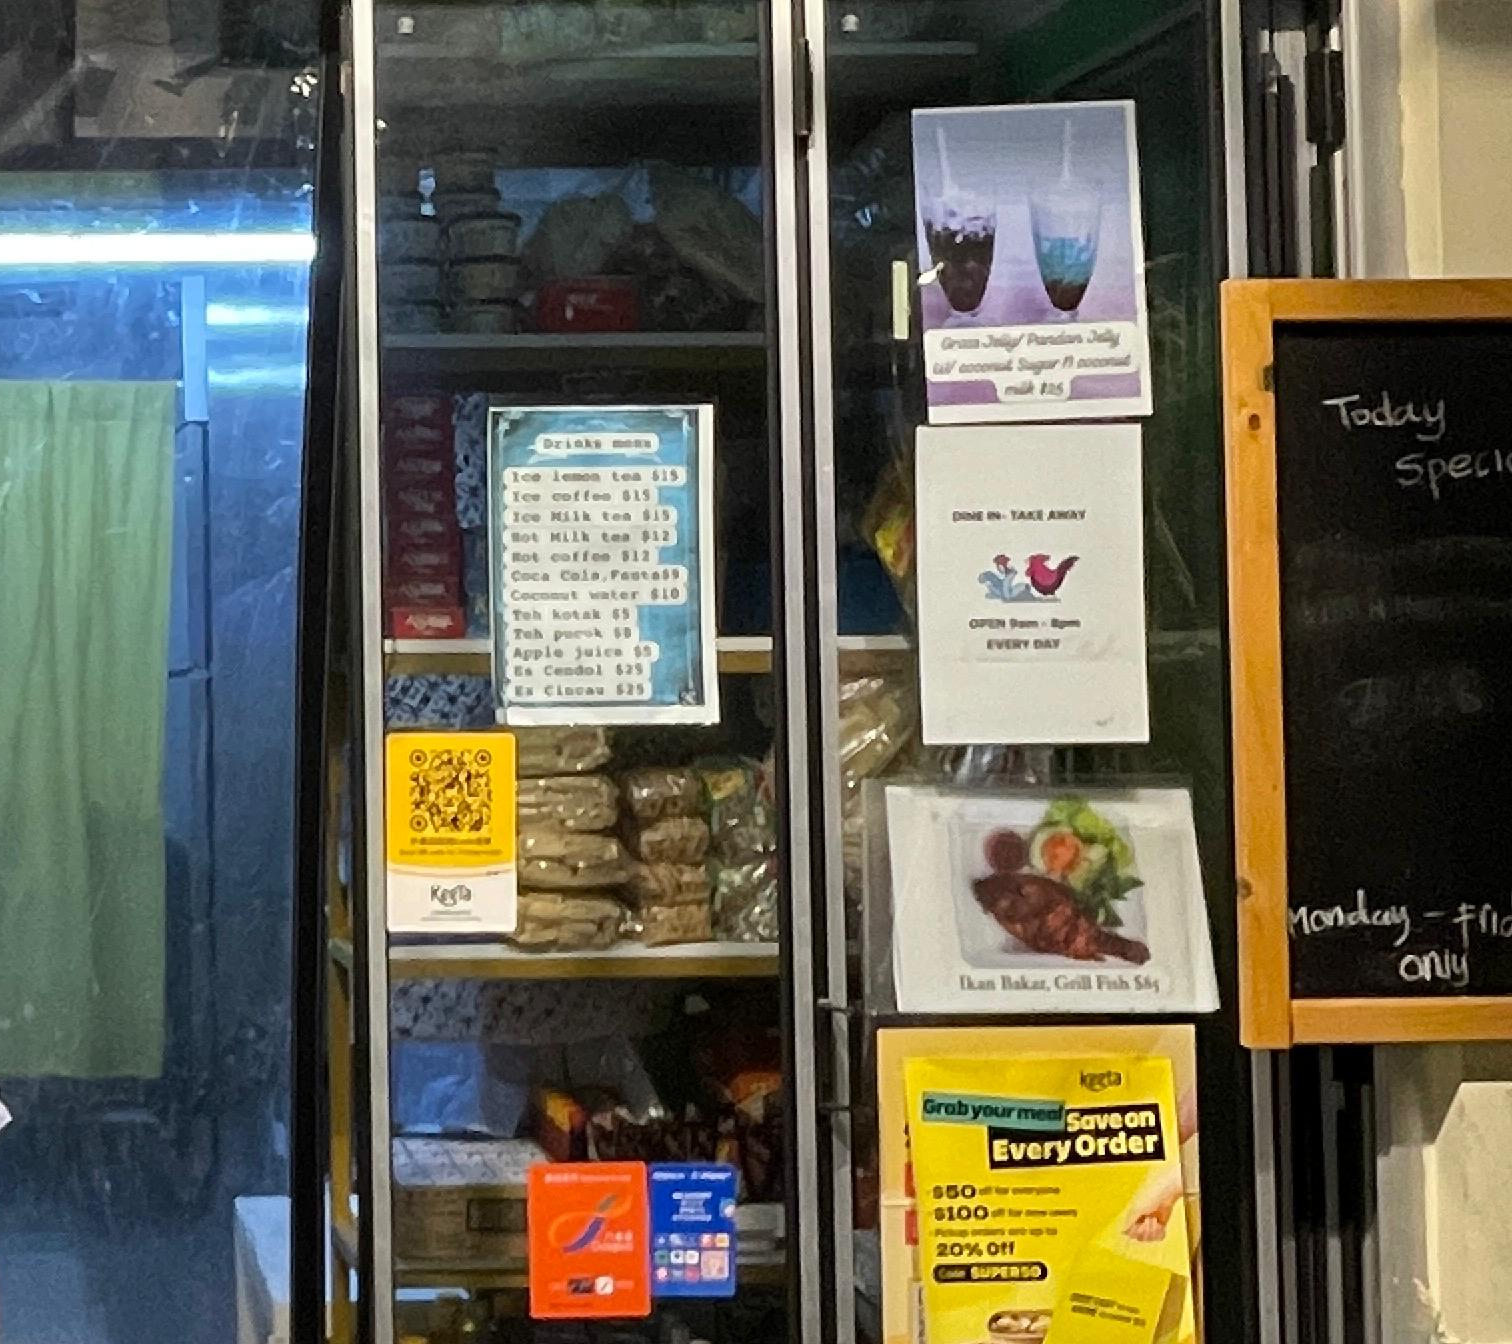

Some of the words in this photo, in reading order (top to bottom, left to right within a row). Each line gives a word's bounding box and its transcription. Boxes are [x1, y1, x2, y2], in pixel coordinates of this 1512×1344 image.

[1321, 390, 1446, 442] Today
[512, 470, 541, 483] Ice
[612, 470, 641, 482] tea
[512, 490, 541, 502] Ice
[552, 489, 611, 502] coffee
[512, 510, 541, 523] Ice
[602, 510, 632, 522] tea
[1011, 510, 1044, 521] TAKE
[1047, 509, 1086, 521] AWAY
[601, 531, 630, 543] tea
[550, 550, 610, 563] coffee
[969, 618, 1006, 629] OPEN
[986, 638, 1030, 650] EVERY
[1033, 638, 1061, 650] DAY
[513, 645, 563, 661] Apple
[1289, 887, 1411, 947] Monday
[1398, 949, 1470, 987] only
[959, 975, 995, 991] Ikan
[1096, 975, 1130, 991] Fish
[923, 1098, 969, 1116] Grab
[970, 1103, 1016, 1120] your
[1017, 1104, 1064, 1122] meal
[1066, 1111, 1123, 1133] Save
[1124, 1109, 1156, 1128] on
[992, 1136, 1072, 1163] Every
[1074, 1130, 1159, 1157] Order
[936, 1242, 984, 1258] 20%
